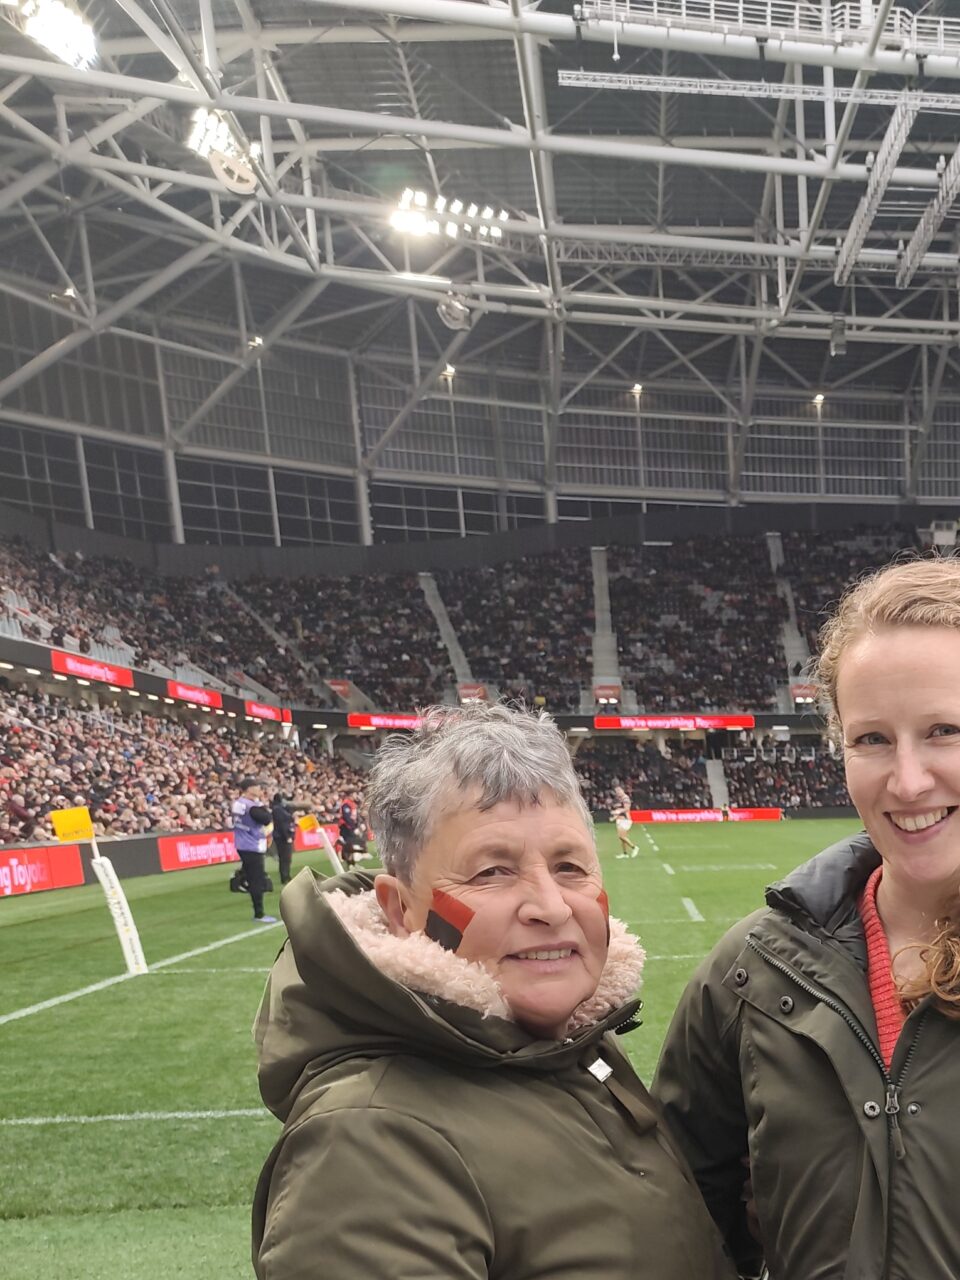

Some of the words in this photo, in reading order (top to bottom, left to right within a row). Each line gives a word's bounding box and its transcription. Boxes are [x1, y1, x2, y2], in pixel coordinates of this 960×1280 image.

[620, 718, 646, 729] We're
[647, 717, 695, 730] everything
[9, 857, 48, 892] Toyota
